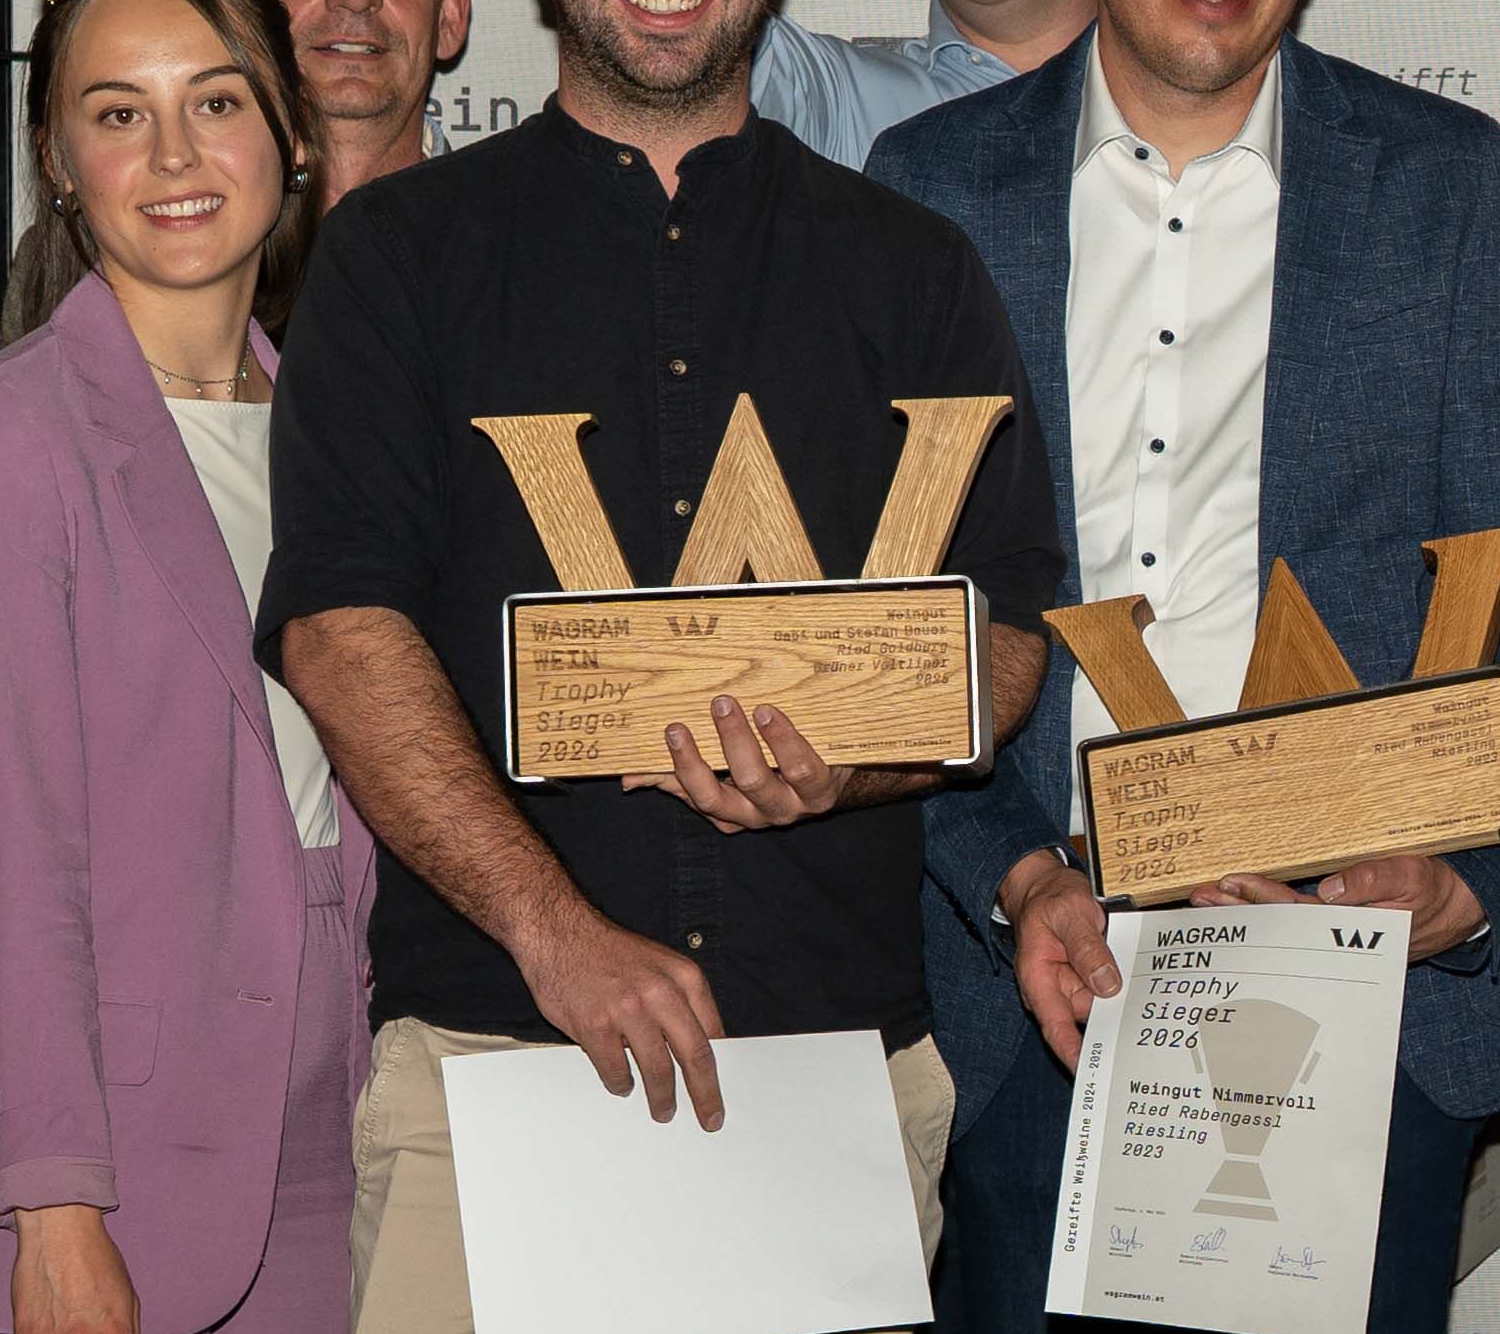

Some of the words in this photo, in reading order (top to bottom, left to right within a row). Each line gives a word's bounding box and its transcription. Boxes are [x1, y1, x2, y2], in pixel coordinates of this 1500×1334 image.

[887, 608, 948, 622] Weingut
[531, 616, 631, 642] WAGRAM
[847, 627, 899, 640] Stefan
[533, 648, 600, 672] WEIN
[837, 643, 872, 657] Ried
[536, 678, 634, 706] Trophy
[536, 710, 634, 734] Sieger
[536, 739, 601, 764] 2026
[1103, 745, 1197, 780] WAGRAM
[1106, 777, 1170, 805] WEIN
[1113, 802, 1202, 833] Trophy
[1115, 828, 1206, 860] Sieger
[1119, 856, 1179, 884] 2026
[1156, 925, 1248, 948] WAGRAM
[1151, 950, 1213, 971] WEIN
[1149, 977, 1239, 1000] Trophy
[1141, 1002, 1237, 1026] Sieger
[1136, 1027, 1200, 1050] 2026
[1088, 1041, 1104, 1070] 2020
[1081, 1081, 1097, 1111] 2024
[1129, 1080, 1203, 1102] Weingut
[1212, 1086, 1317, 1111] Nimmervoll
[1126, 1100, 1171, 1118] Ried
[1178, 1105, 1284, 1128] Rabengassl
[1123, 1121, 1209, 1145] Riesling
[1072, 1117, 1092, 1186] Weißweine
[1121, 1142, 1165, 1159] 2023
[1063, 1191, 1083, 1254] Gereifte
[1104, 1289, 1165, 1303] wagramwein.at
